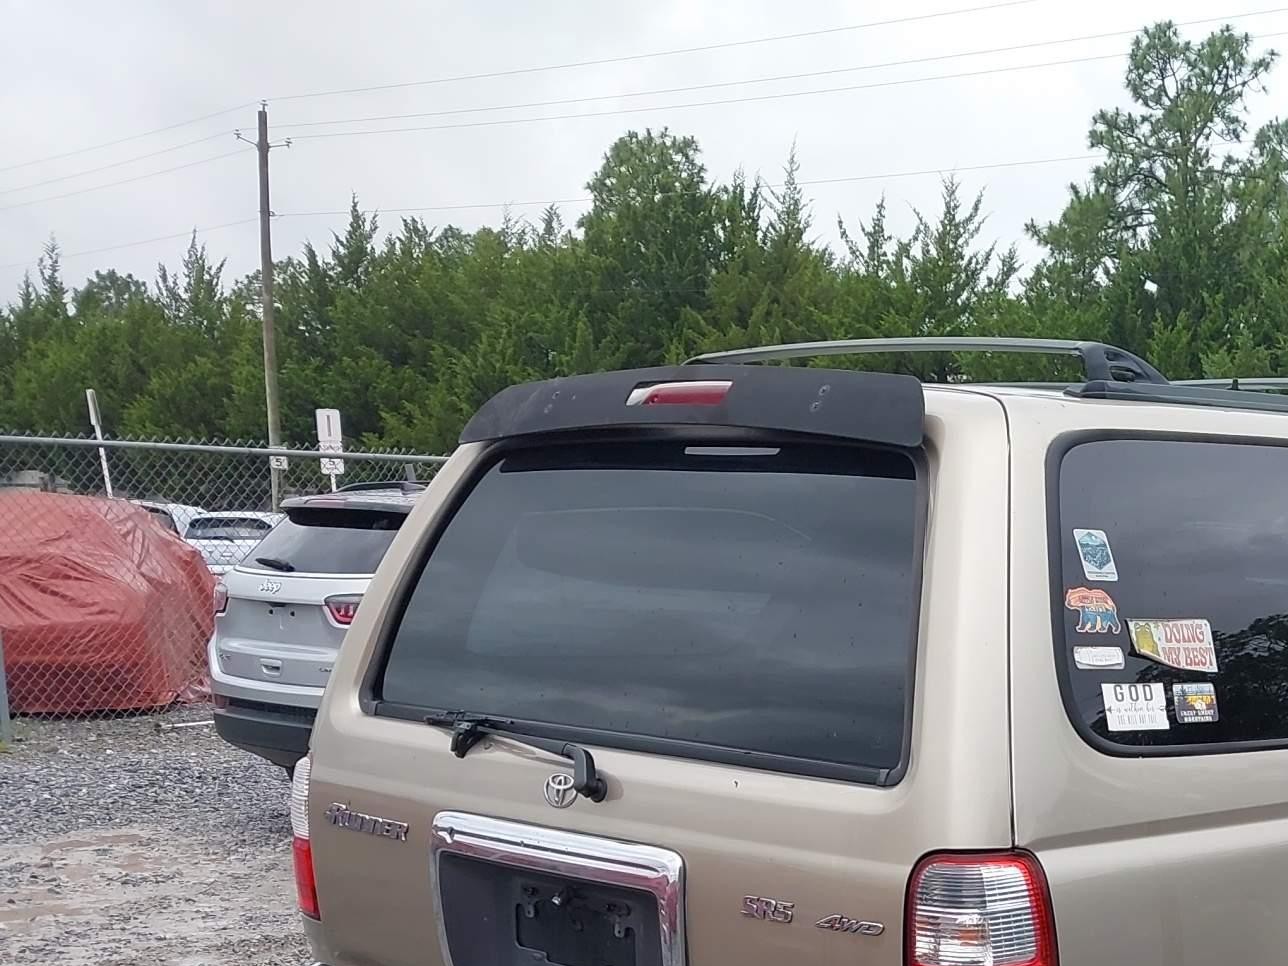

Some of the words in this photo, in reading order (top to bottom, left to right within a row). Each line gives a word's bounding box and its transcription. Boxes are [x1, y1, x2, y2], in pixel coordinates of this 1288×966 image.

[1161, 622, 1205, 644] DOING
[1161, 646, 1181, 667] MY
[1182, 646, 1214, 668] BEST
[1113, 684, 1154, 703] GOD
[740, 895, 795, 923] SR5
[815, 914, 885, 936] 4WD
